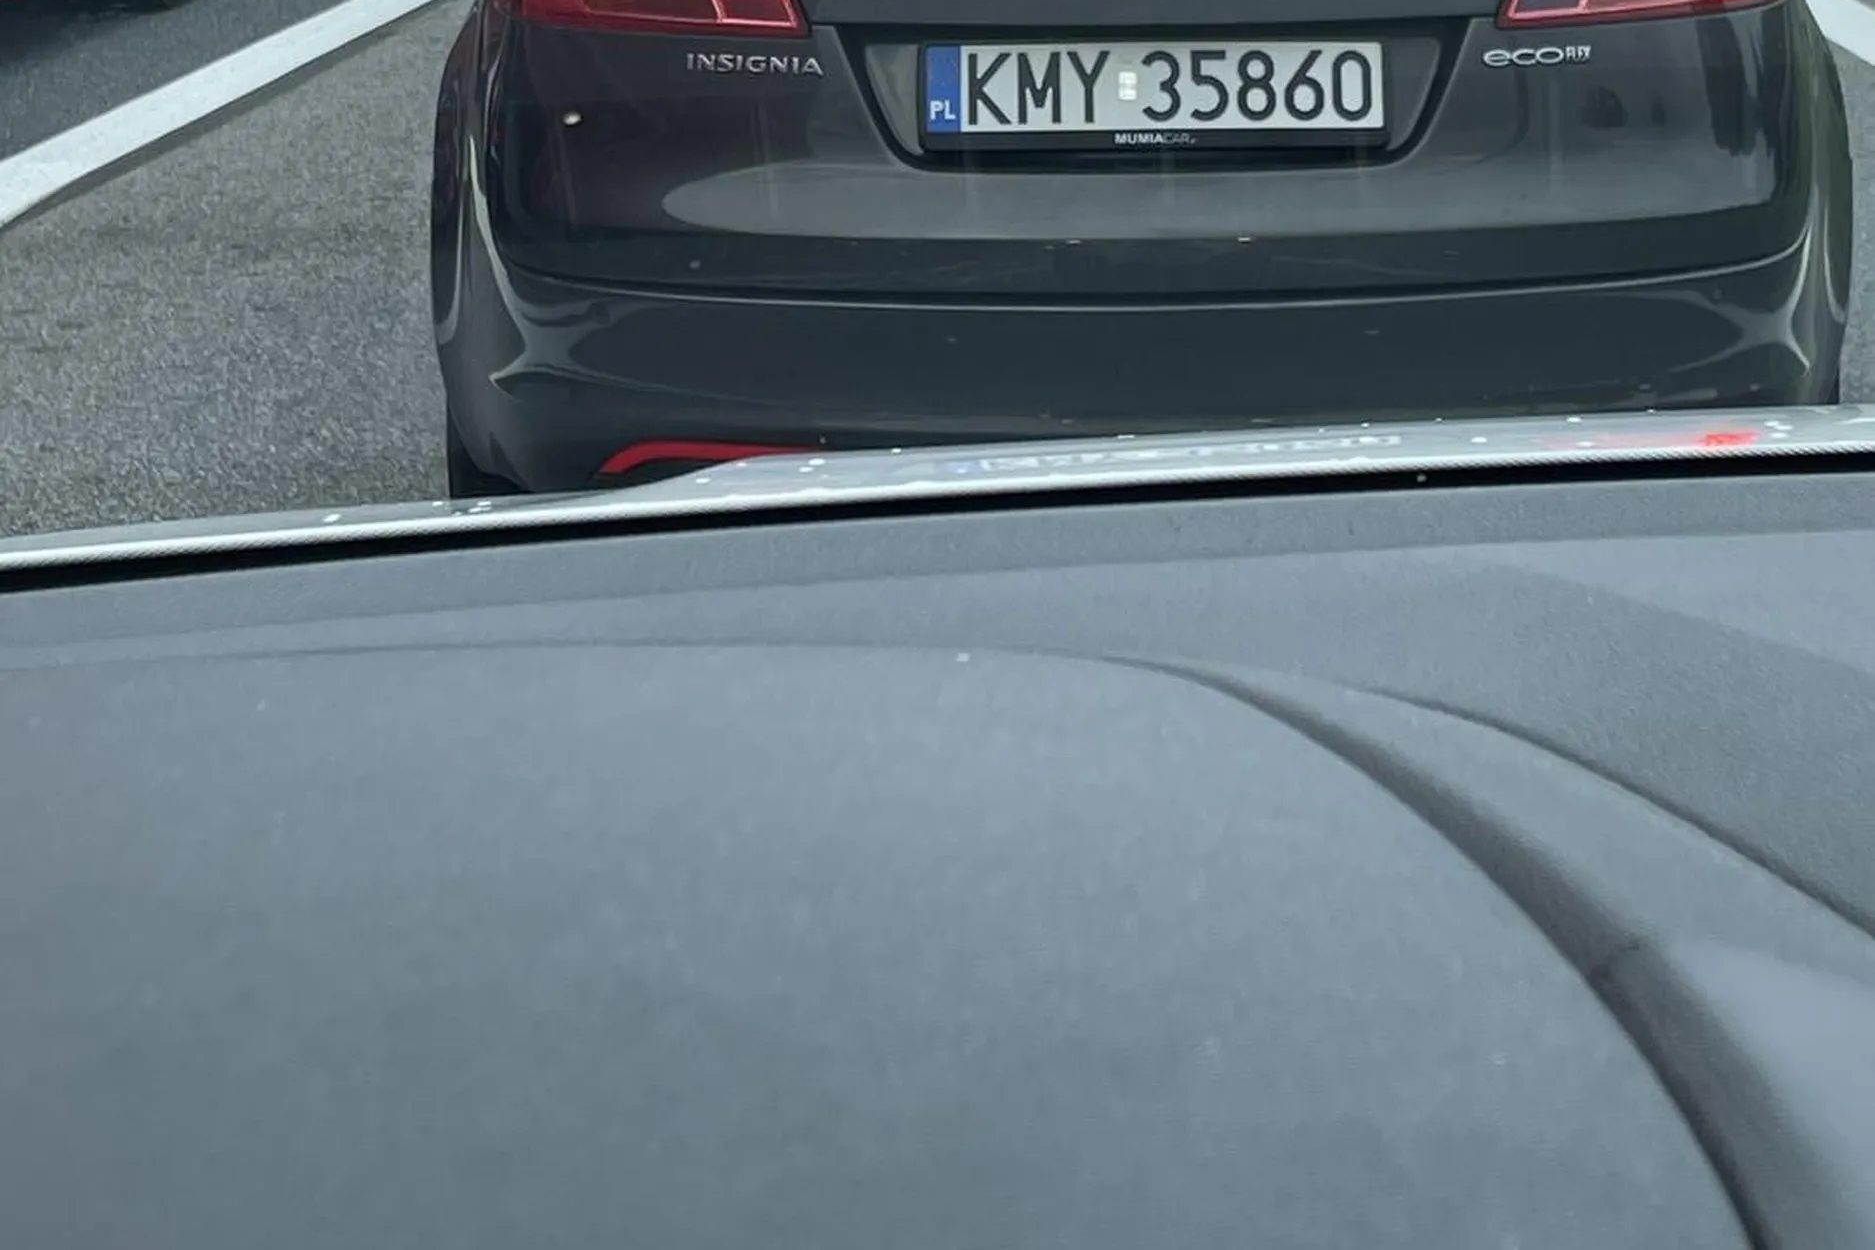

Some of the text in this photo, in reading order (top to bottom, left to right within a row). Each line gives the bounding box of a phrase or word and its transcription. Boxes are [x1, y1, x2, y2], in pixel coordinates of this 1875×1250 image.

[686, 52, 824, 77] INSIGNIA
[929, 48, 1373, 126] PL KMY 35860
